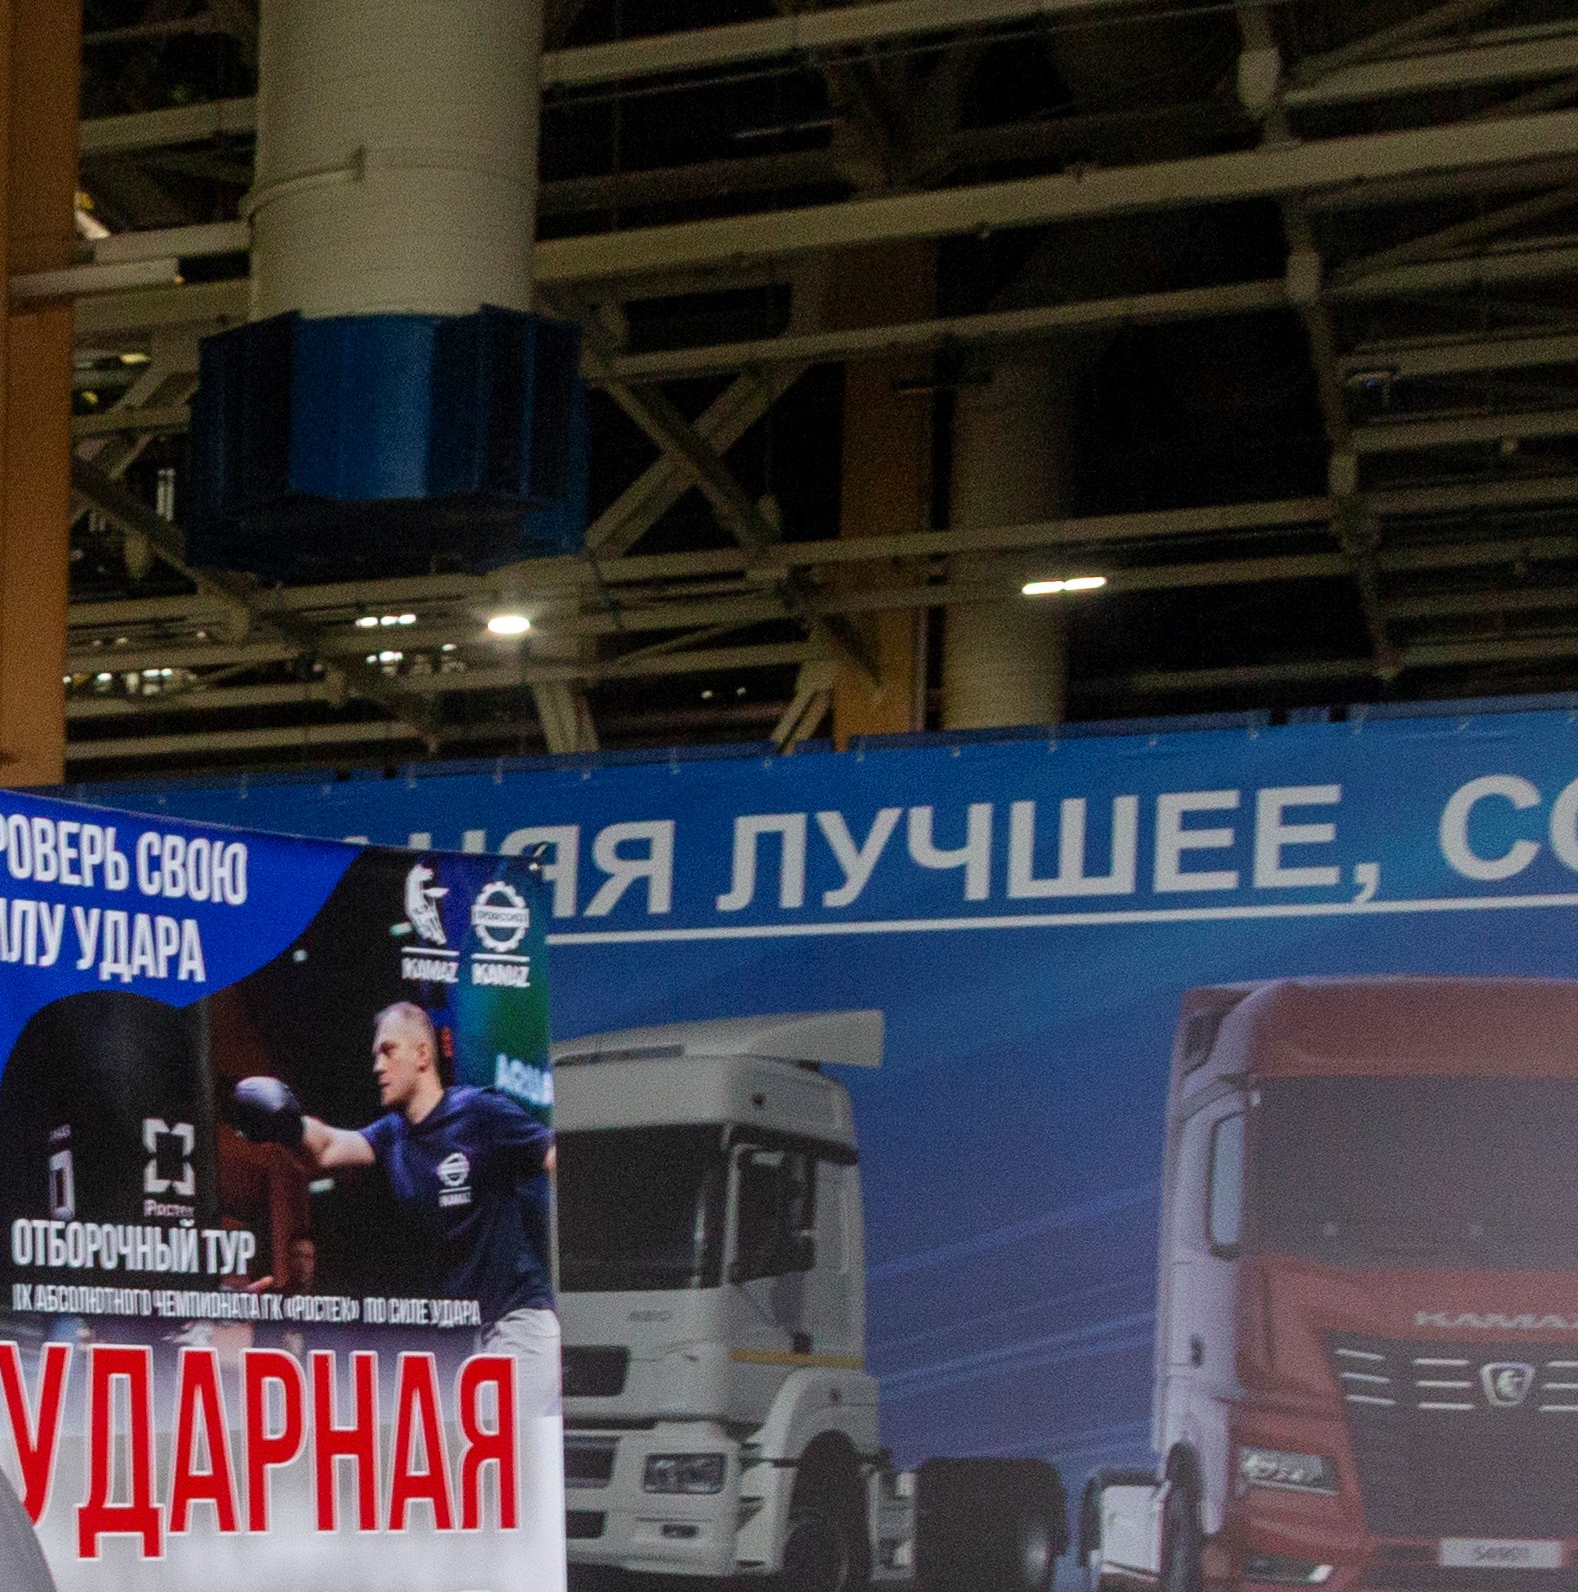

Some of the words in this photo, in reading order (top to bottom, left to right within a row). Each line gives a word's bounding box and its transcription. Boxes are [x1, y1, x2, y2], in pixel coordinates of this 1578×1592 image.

[136, 832, 248, 906] СВОЮ
[717, 783, 1379, 912] ЛУЧШЕЕ,
[1439, 773, 1578, 882] С
[74, 906, 207, 983] УДАРА
[11, 1218, 198, 1276] ОТБОРОЧНЫЙ
[202, 1230, 255, 1277] ТУР
[34, 1284, 152, 1316] АБСОЛЮТНОГО
[153, 1289, 260, 1319] ЧЕМПИОНАТА
[363, 1297, 387, 1324] ПО
[388, 1298, 429, 1325] СИЛЕ
[430, 1299, 481, 1328] УДАРА
